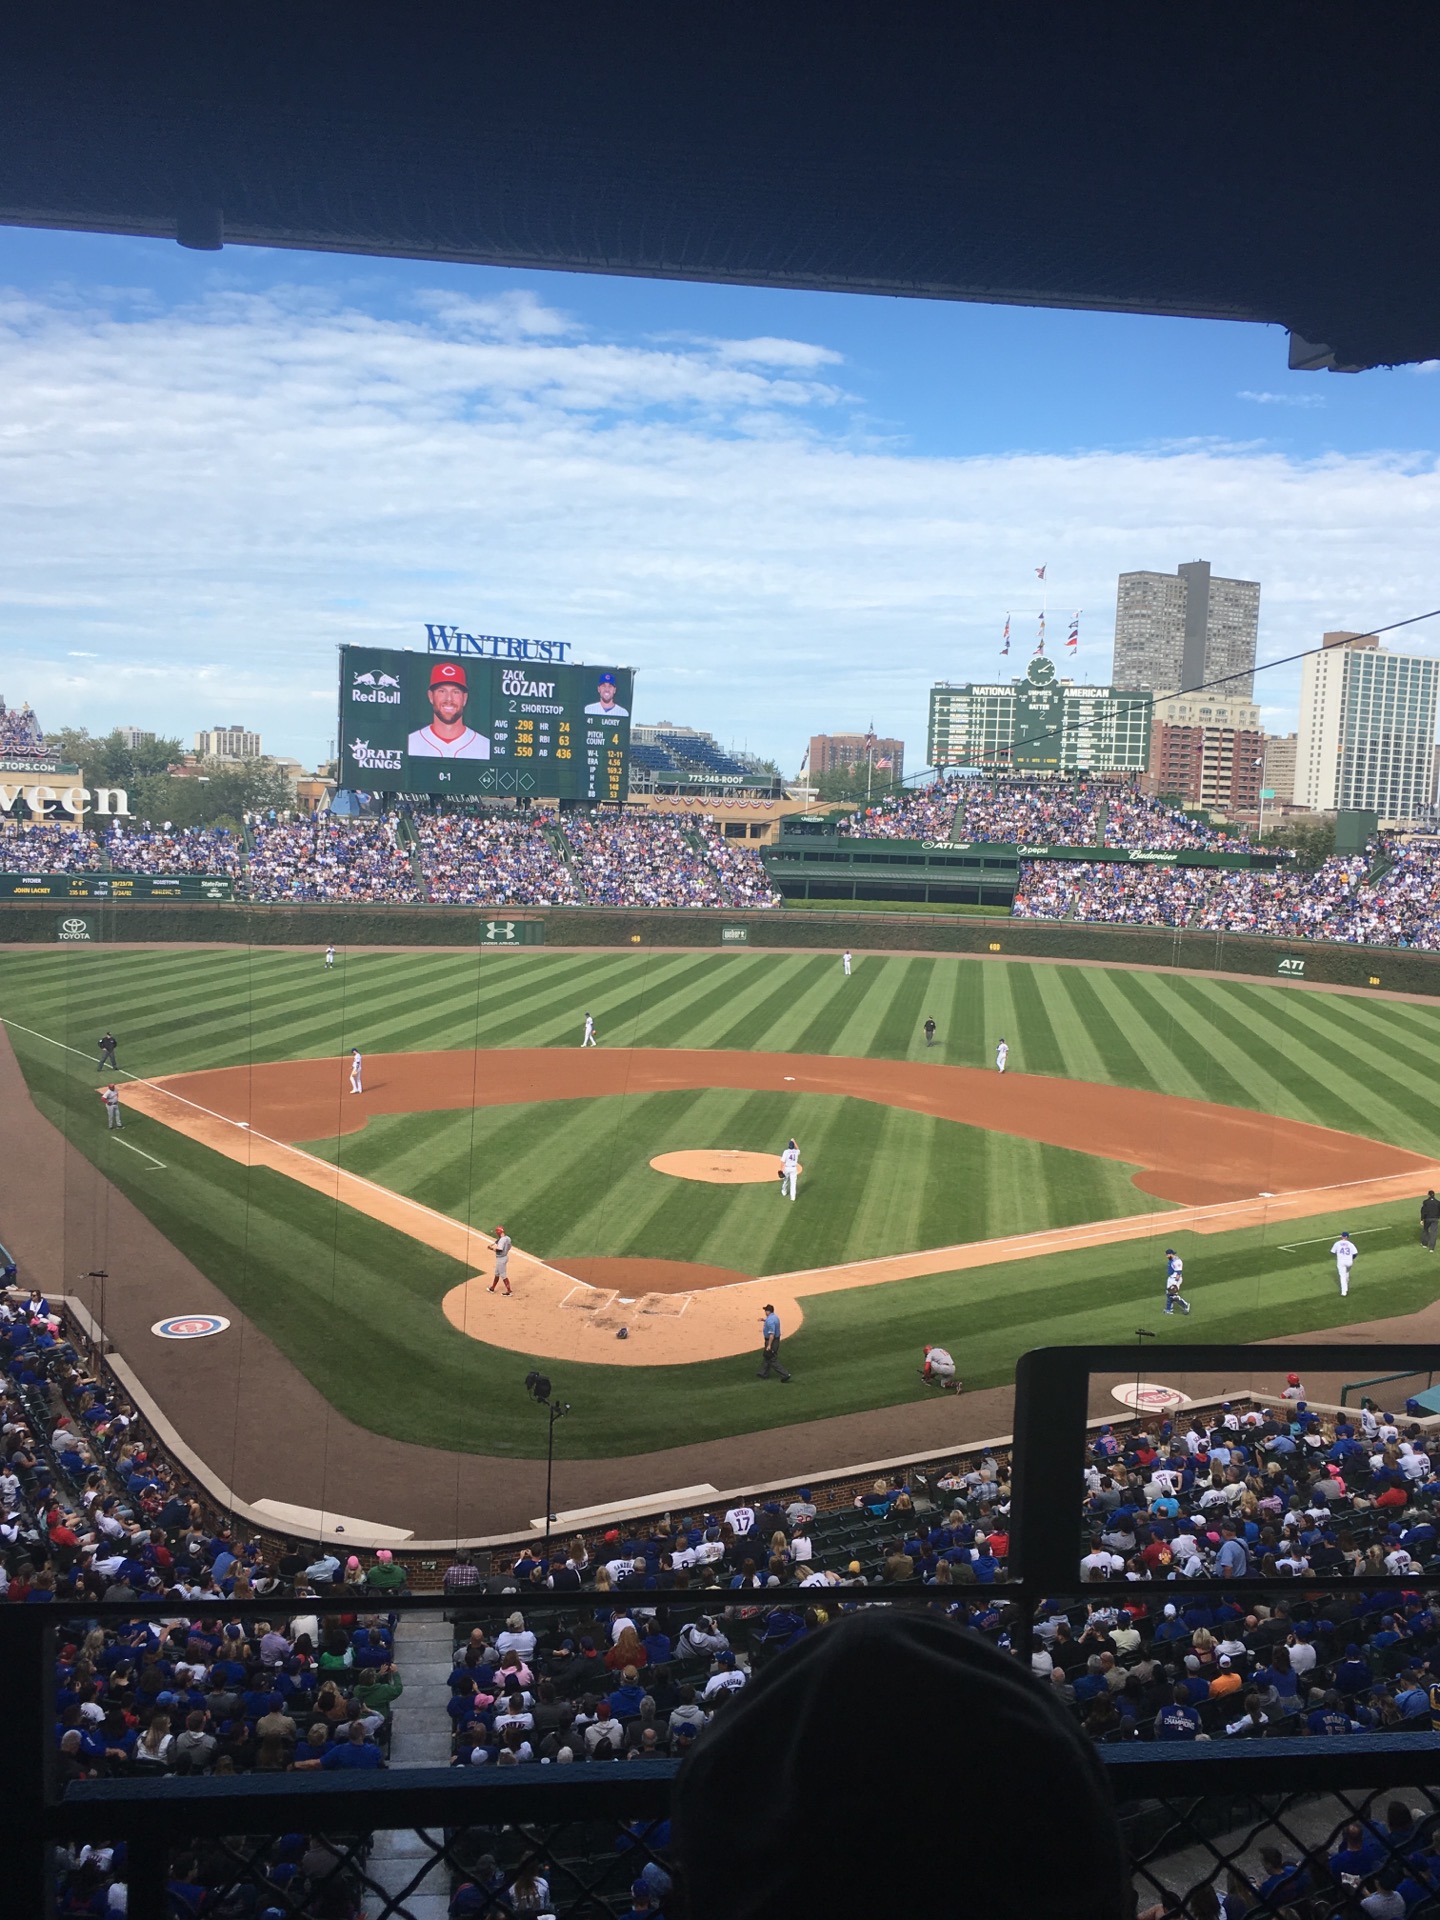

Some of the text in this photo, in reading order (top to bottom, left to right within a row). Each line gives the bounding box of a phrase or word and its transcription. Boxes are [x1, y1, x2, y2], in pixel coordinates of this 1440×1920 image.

[424, 624, 571, 662] WINTRUST
[502, 669, 525, 680] ZACK
[502, 680, 555, 698] COZART
[972, 687, 1017, 696] NATIONAL
[1063, 688, 1109, 698] AMERICAN
[352, 689, 400, 704] Red Bull
[509, 700, 564, 715] 2 SHORTSTOP
[1039, 711, 1046, 720] 2
[494, 720, 508, 728] AVG
[515, 720, 533, 730] .298
[559, 722, 570, 732] 24
[494, 733, 570, 745] OBP .386 RBI 63
[588, 731, 603, 739] PITCH
[612, 733, 619, 745] 4
[352, 748, 403, 760] DRAFT
[514, 747, 533, 757] .550
[556, 749, 571, 759] 436
[358, 759, 401, 770] KINGS
[439, 772, 451, 781] 0-1
[688, 774, 744, 784] 773-248-ROOF
[1128, 850, 1178, 860] Budweiser
[1278, 959, 1305, 970] ATI
[1340, 1247, 1350, 1255] 43
[736, 1517, 750, 1531] 17
[1164, 1717, 1195, 1730] CHAMPIONS
